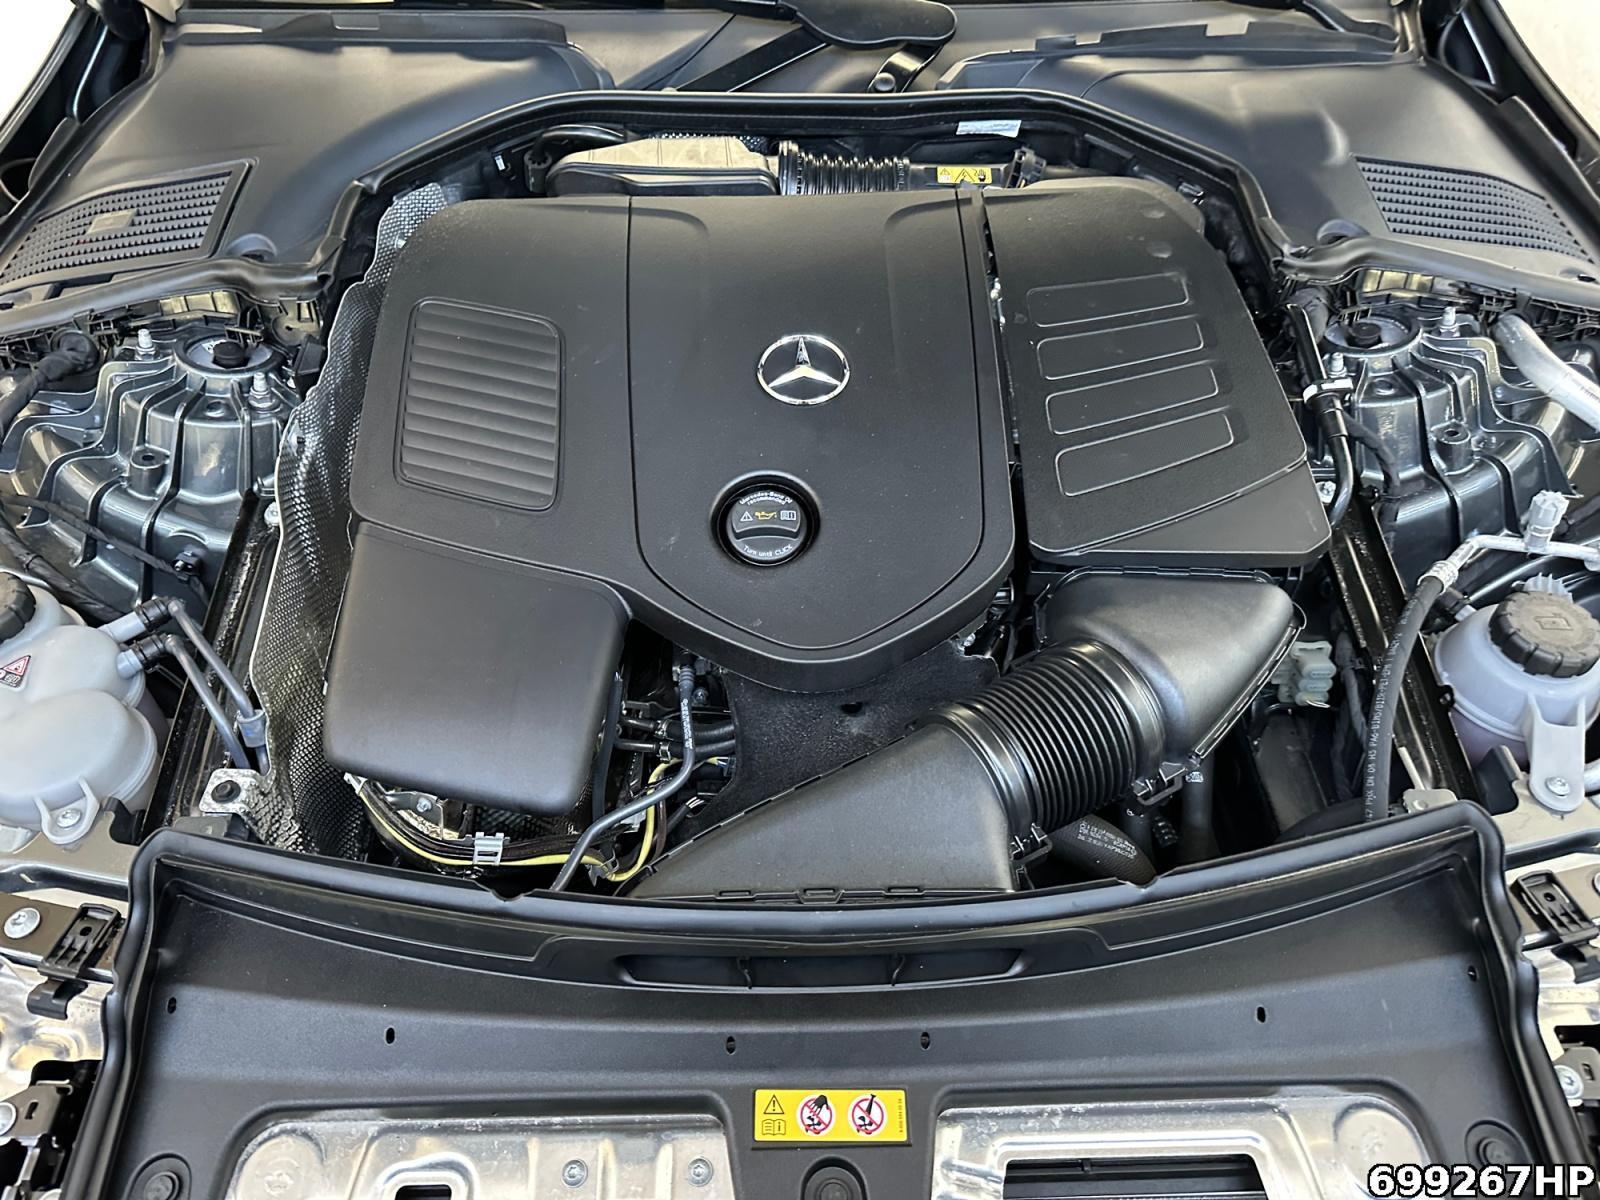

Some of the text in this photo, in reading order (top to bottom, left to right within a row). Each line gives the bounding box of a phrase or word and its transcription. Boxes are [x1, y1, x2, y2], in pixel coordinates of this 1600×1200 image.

[739, 491, 785, 505] Mercedes-Benz
[747, 496, 785, 505] recommended
[744, 545, 757, 556] Turn
[775, 545, 792, 556] CLICK
